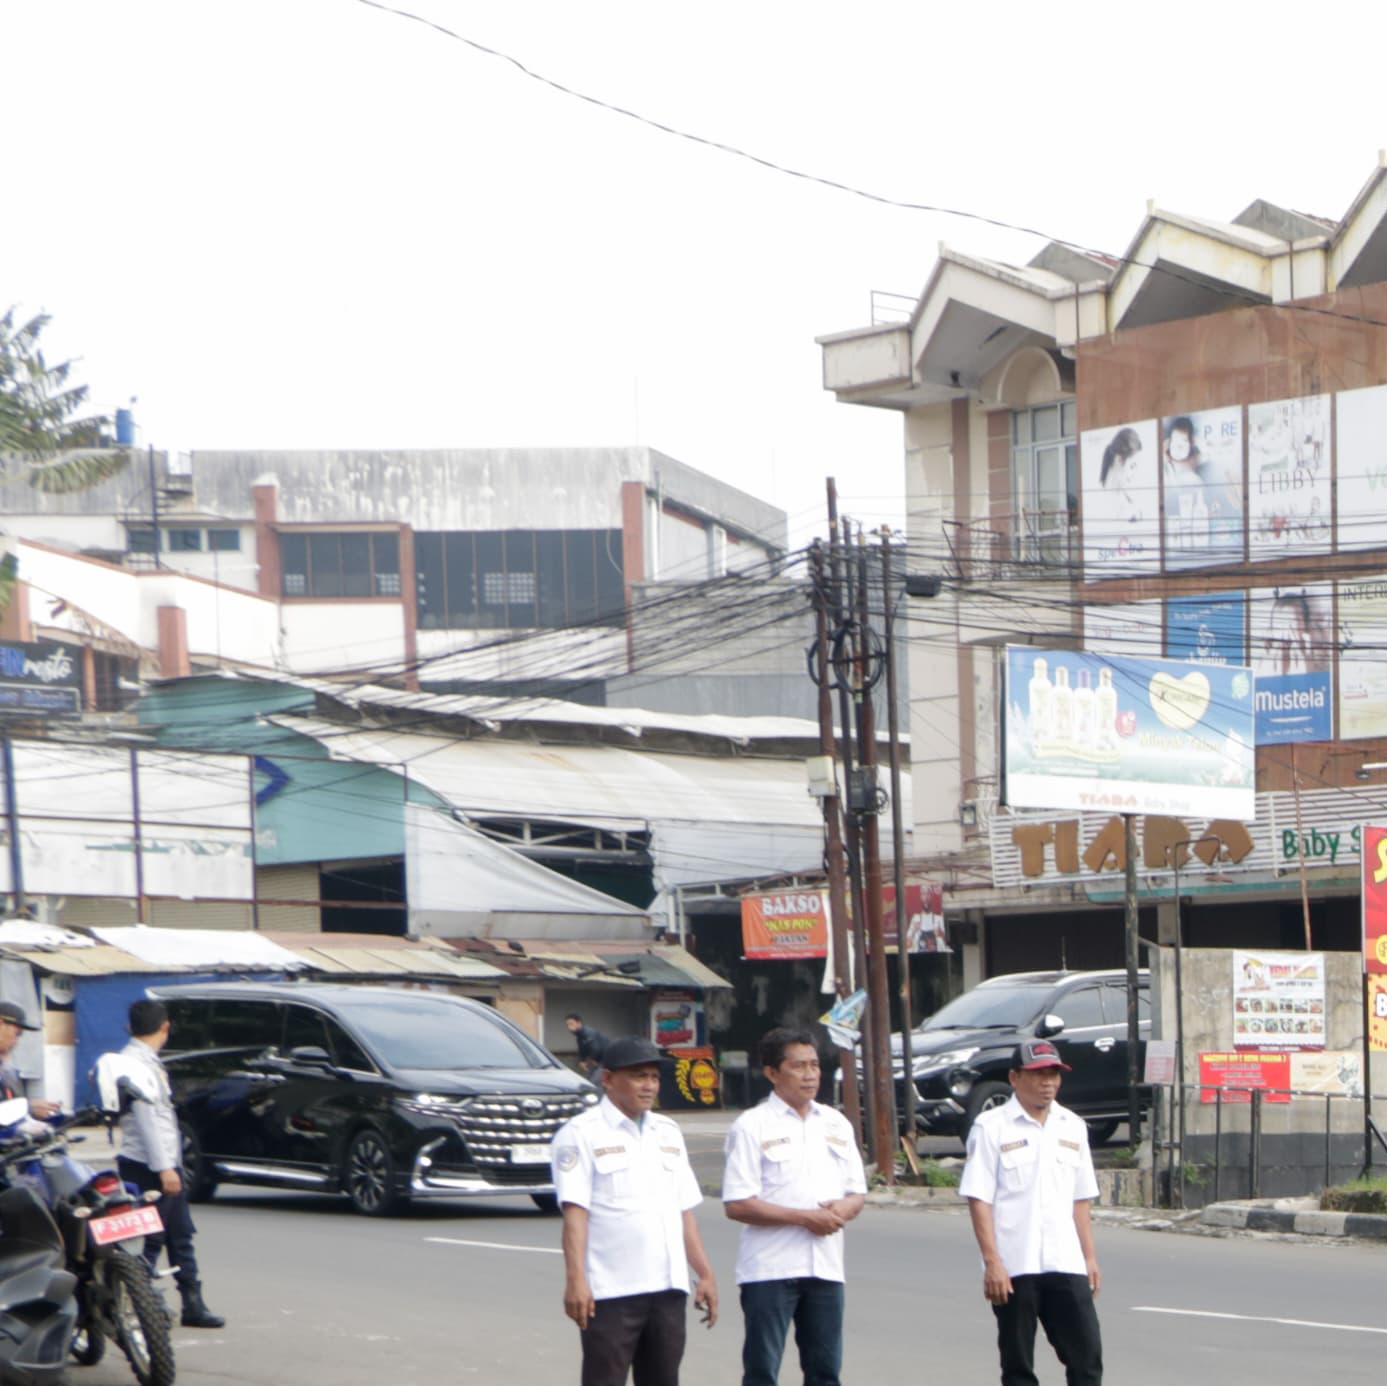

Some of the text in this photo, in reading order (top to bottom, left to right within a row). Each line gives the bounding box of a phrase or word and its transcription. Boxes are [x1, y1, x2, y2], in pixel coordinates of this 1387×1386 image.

[1258, 468, 1319, 494] LIBBY
[1011, 815, 1255, 878] TIARA
[760, 894, 821, 917] BAKSO
